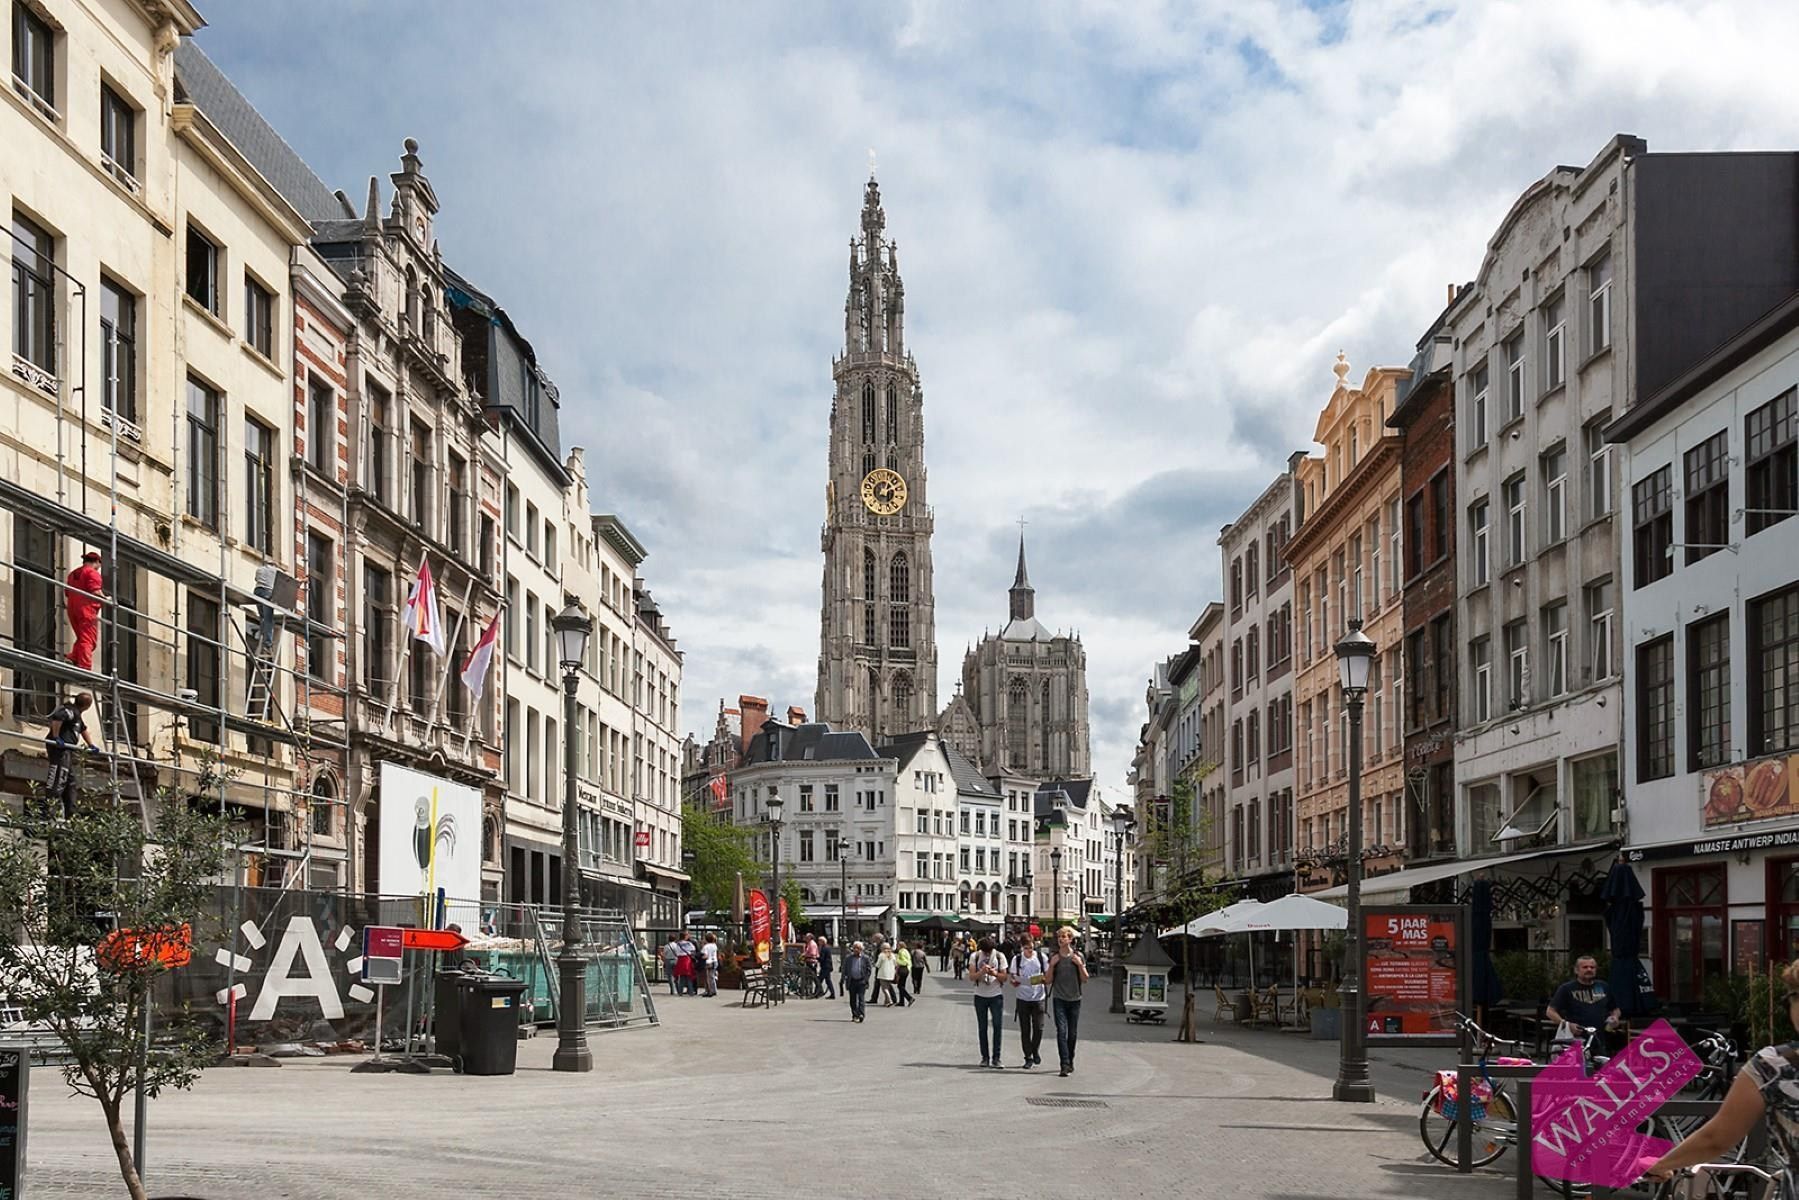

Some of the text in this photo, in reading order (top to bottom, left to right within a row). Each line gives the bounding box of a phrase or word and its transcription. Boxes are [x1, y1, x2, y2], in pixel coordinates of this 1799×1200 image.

[1693, 831, 1799, 855] NAMASTE ANTWERP INDIA
[1388, 919, 1399, 934] 5
[1401, 918, 1427, 930] JAAR
[1403, 929, 1428, 939] MAS
[248, 916, 345, 1020] A
[1370, 1020, 1379, 1030] A
